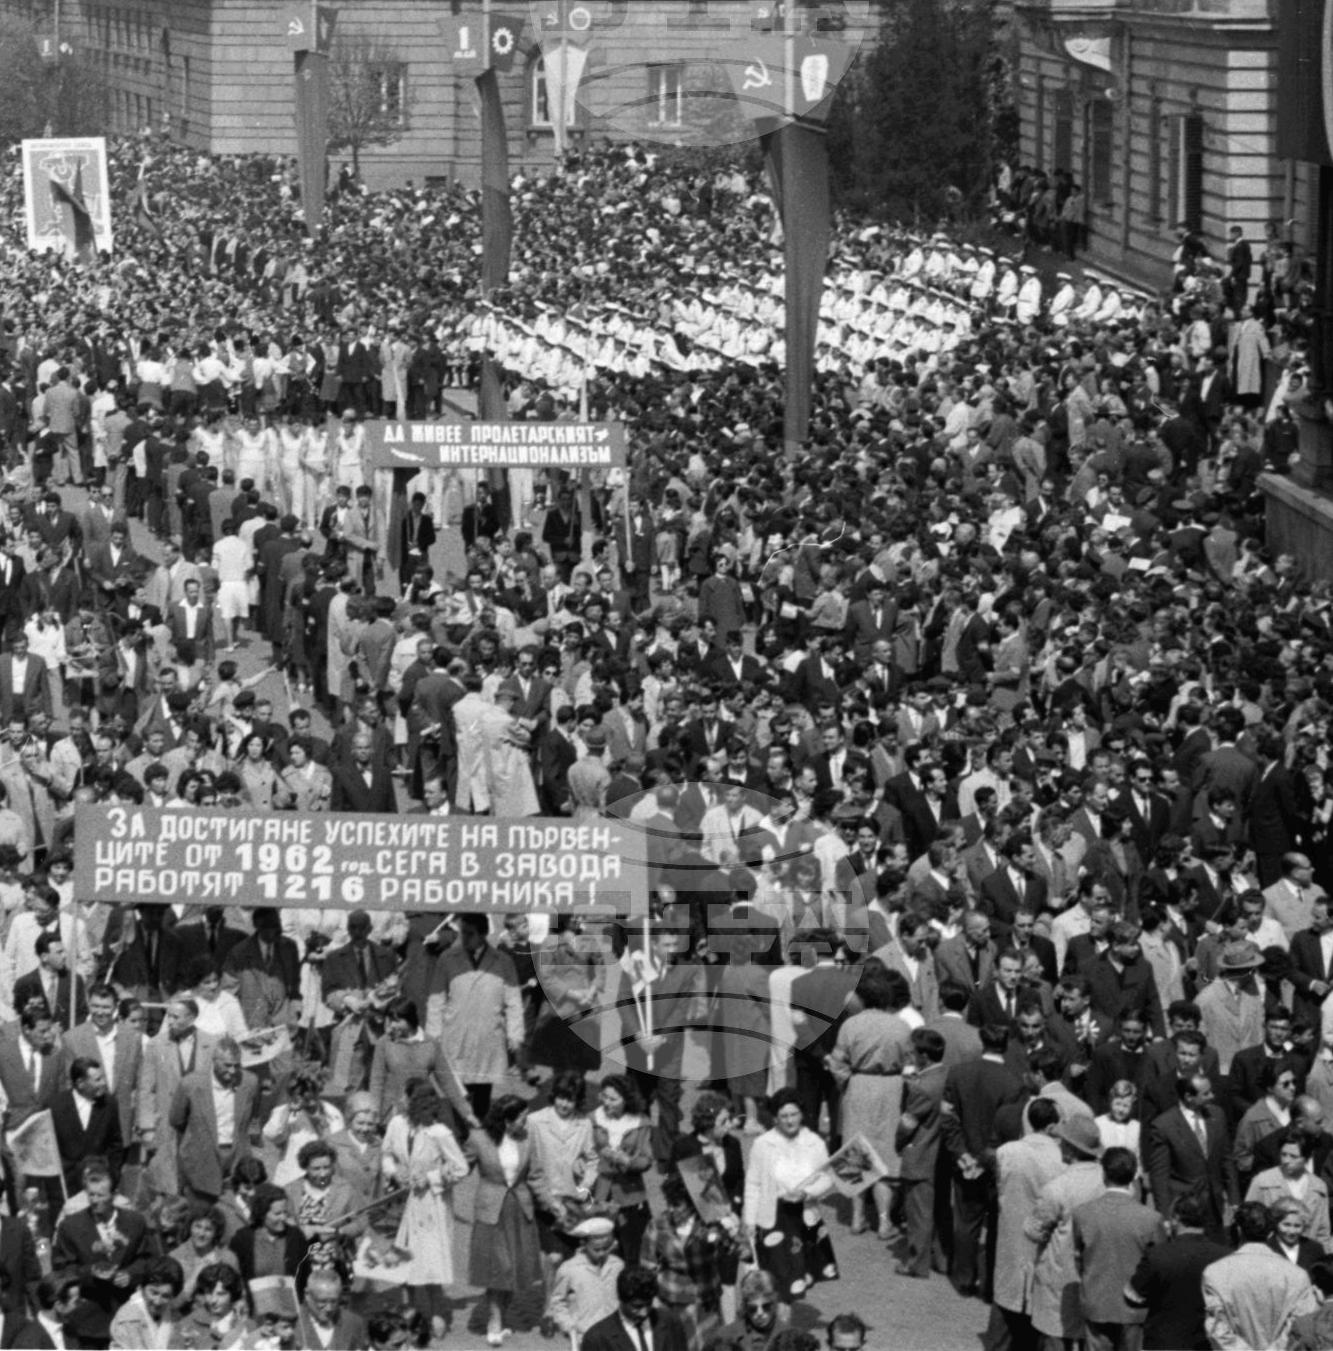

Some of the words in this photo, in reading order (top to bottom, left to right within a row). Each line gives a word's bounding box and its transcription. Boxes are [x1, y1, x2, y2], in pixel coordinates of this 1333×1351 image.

[459, 26, 469, 50] 1
[384, 424, 405, 443] ДА
[412, 424, 462, 443] ЖИВЕЕ
[471, 425, 595, 444] ПРОЛЕТАРСКИЯТ
[439, 445, 611, 463] ИНТЕРНАЦИОНАЛИЗЪМ
[107, 808, 144, 839] ЗА
[159, 814, 312, 842] ДОСТИГАНЕ
[325, 818, 448, 846] УСПЕХИТЕ
[462, 823, 497, 848] НА
[508, 825, 621, 851] ПЪРВЕН-
[95, 841, 168, 869] ЦИТЕ
[186, 844, 221, 869] ОТ
[236, 846, 332, 872] 1962
[377, 851, 446, 876] СЕГА
[460, 853, 479, 876] В
[496, 853, 621, 882] ЗАВОДА
[95, 869, 244, 898] РАБОТЯТ
[257, 874, 364, 901] 1216
[380, 879, 574, 907] РАБОТНИКА
